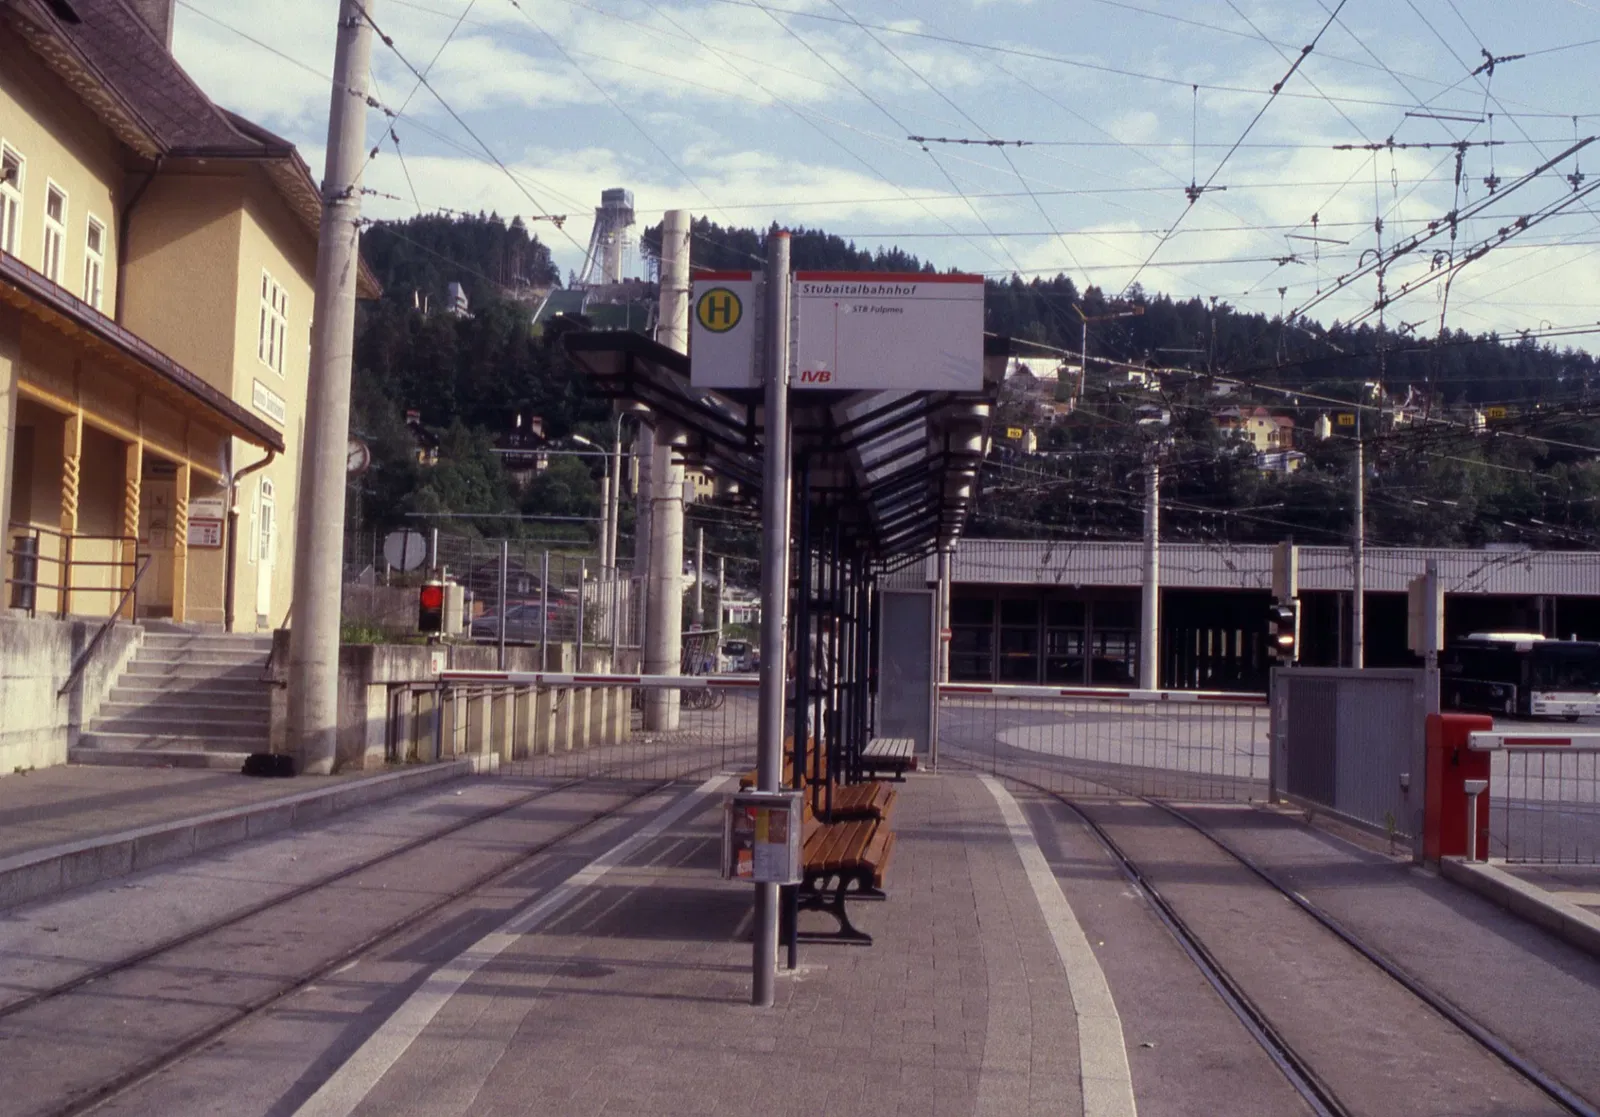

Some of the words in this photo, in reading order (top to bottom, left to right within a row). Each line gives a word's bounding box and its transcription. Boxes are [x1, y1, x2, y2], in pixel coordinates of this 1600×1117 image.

[802, 283, 917, 296] Stubaitalbahnhof
[708, 295, 731, 324] H
[852, 305, 869, 314] STB
[870, 305, 904, 315] Fulpmes
[800, 371, 831, 383] IVB
